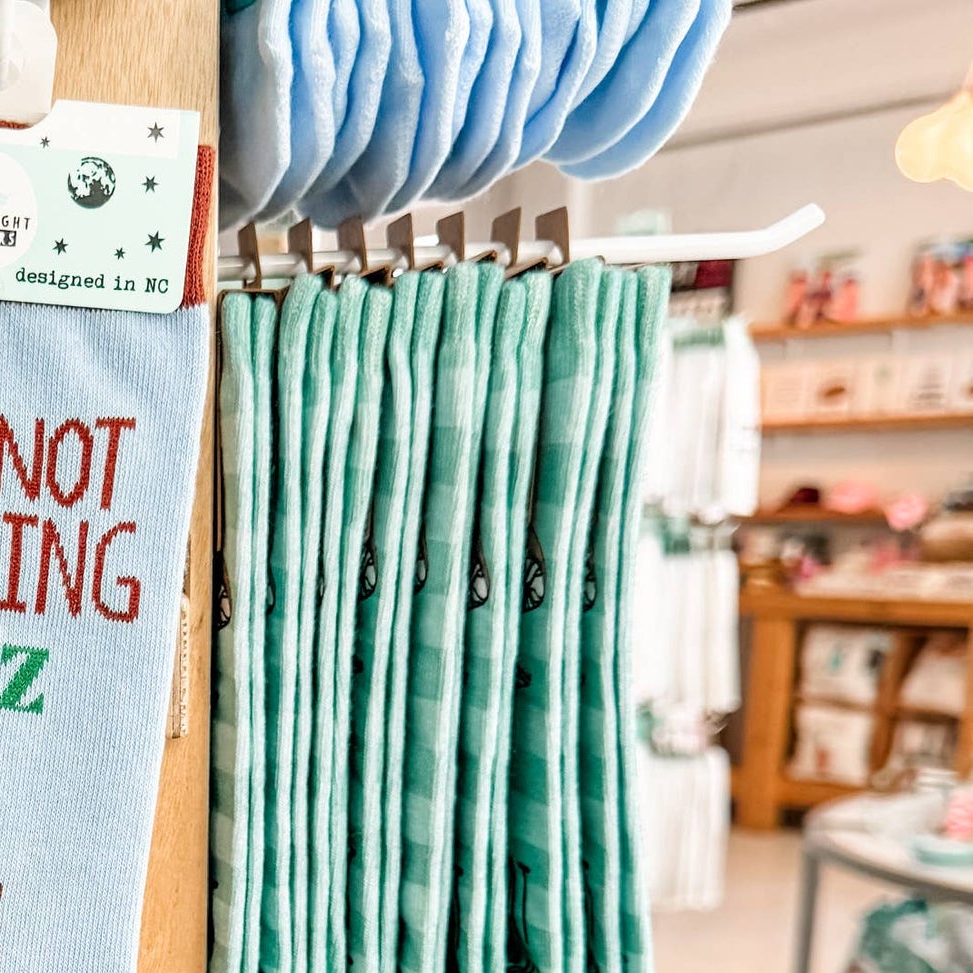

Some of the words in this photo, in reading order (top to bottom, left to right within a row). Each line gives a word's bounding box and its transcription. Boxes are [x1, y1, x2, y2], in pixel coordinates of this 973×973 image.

[15, 267, 105, 290] designed
[113, 275, 136, 291] in
[145, 277, 169, 294] NC
